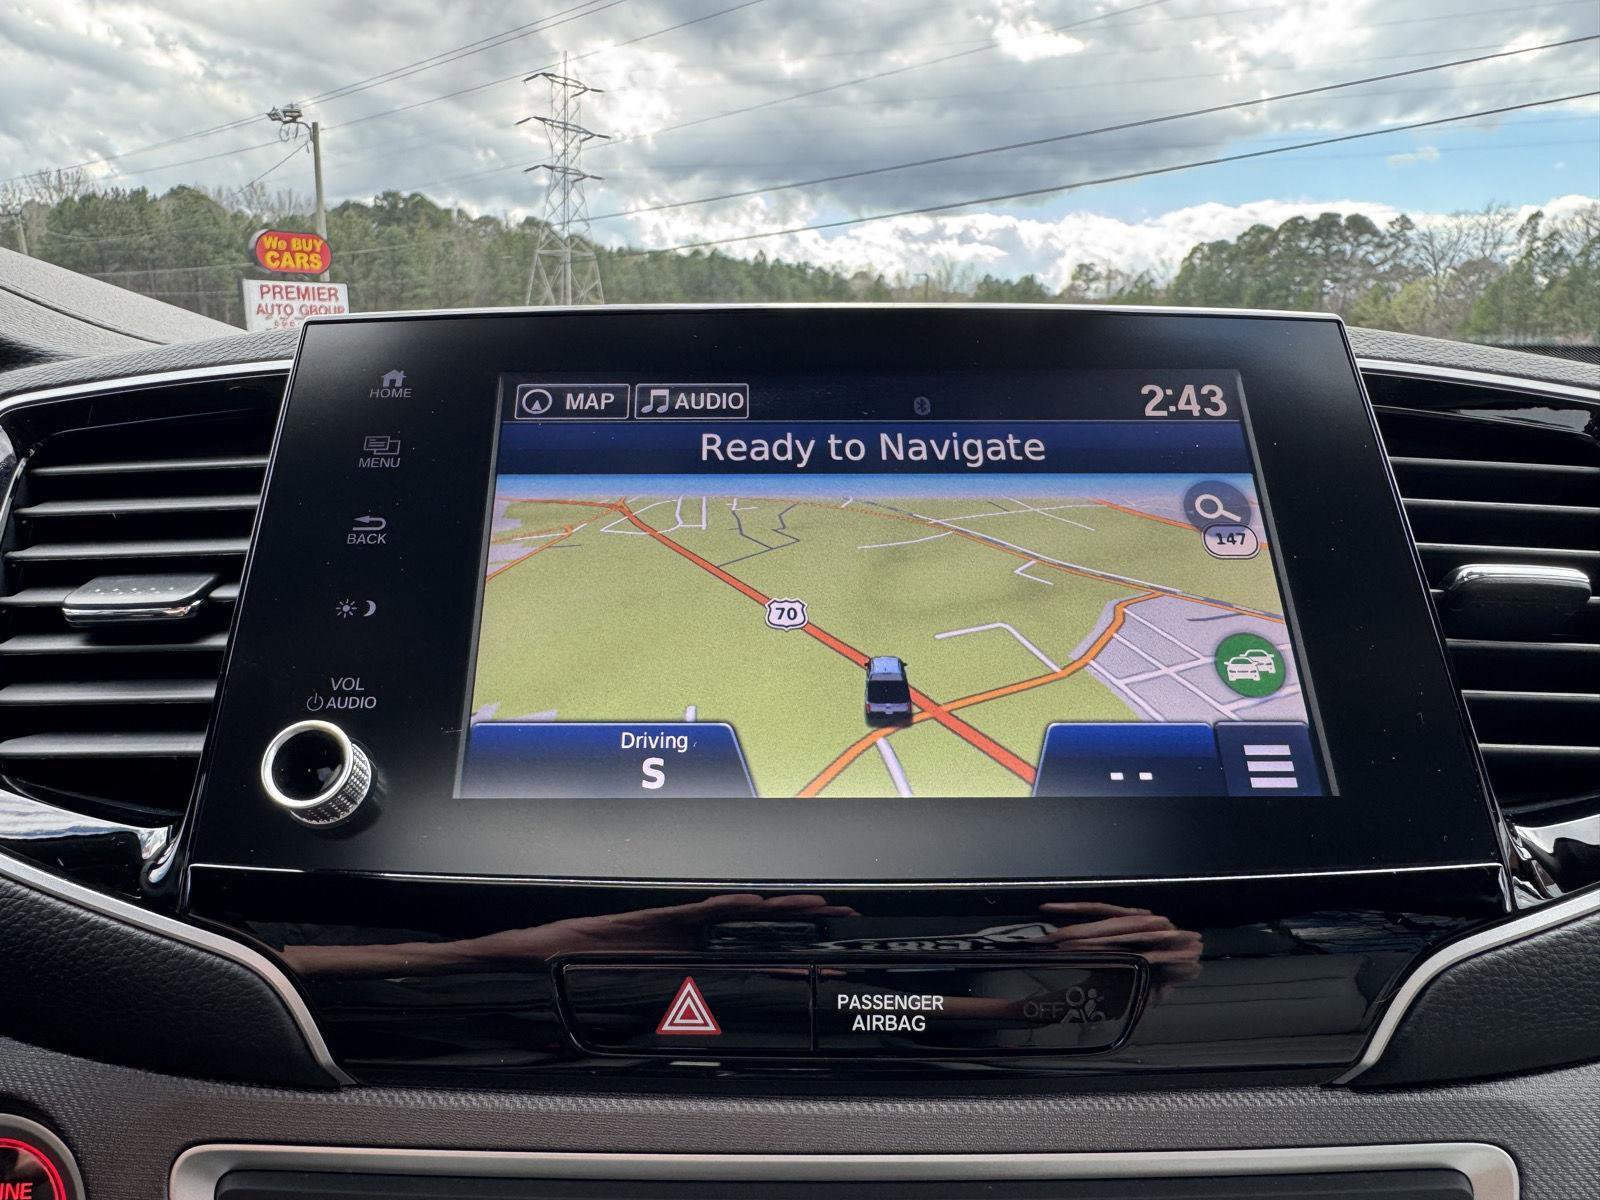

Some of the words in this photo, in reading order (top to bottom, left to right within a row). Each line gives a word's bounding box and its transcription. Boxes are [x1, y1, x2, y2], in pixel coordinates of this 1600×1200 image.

[291, 238, 323, 252] BUY
[264, 250, 322, 270] CARS
[260, 284, 339, 302] PREMIER
[256, 303, 294, 316] AUTO
[299, 304, 345, 316] GROUP
[369, 388, 412, 399] HOME
[565, 393, 615, 410] MAP
[674, 392, 745, 411] AUDIO
[1140, 384, 1228, 417] 2:43
[701, 432, 815, 468] Ready
[828, 437, 866, 462] to
[880, 432, 1046, 468] Navigate
[358, 457, 401, 468] MENU
[346, 533, 387, 545] BACK
[1215, 533, 1246, 546] 147
[775, 607, 798, 621] 70
[331, 677, 365, 691] VOL
[325, 696, 377, 709] AUDIO
[621, 731, 689, 753] Driving
[641, 757, 666, 790] S
[837, 994, 945, 1011] PASSENGER
[1023, 1001, 1066, 1019] OFF
[852, 1014, 926, 1032] AIRBAG
